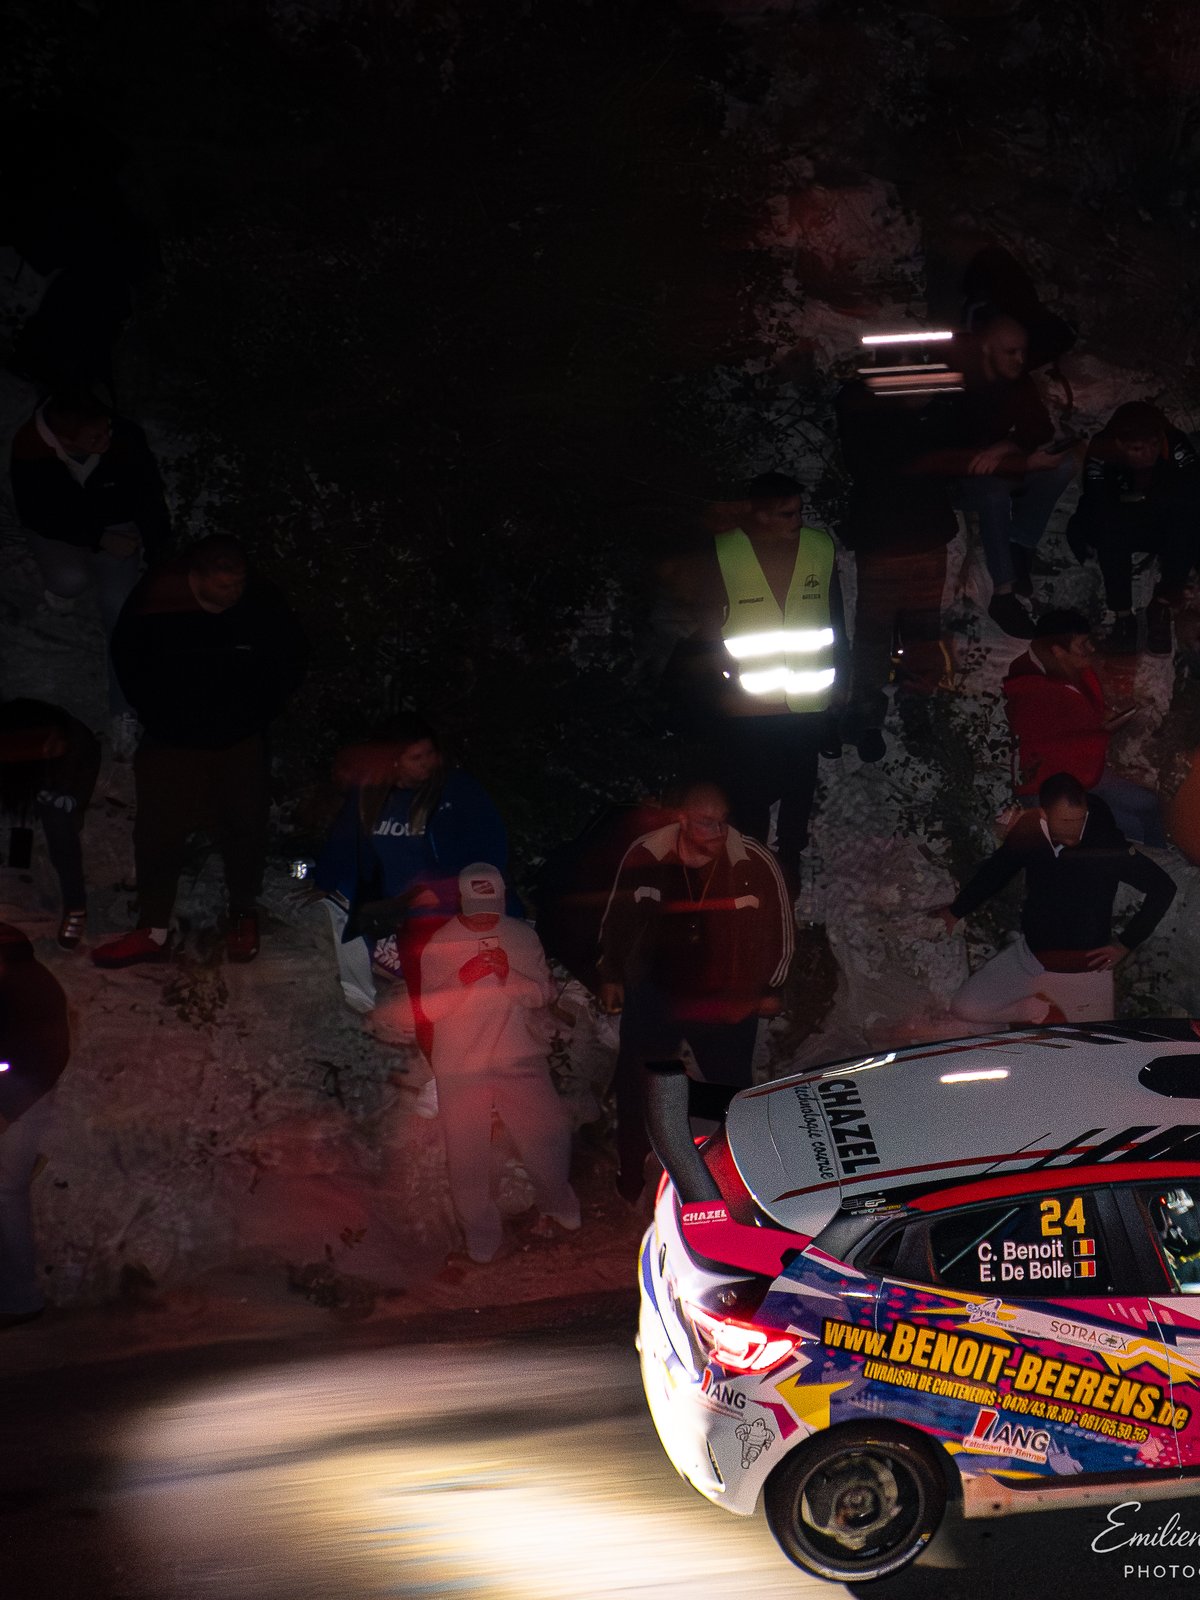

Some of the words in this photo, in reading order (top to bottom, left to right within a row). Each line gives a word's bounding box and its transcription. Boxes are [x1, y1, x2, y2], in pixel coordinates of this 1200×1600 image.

[818, 1079, 880, 1174] CHAZEL
[682, 1209, 727, 1222] CHAZEL
[1040, 1197, 1085, 1236] 24
[978, 1242, 998, 1261] C.
[1003, 1240, 1064, 1260] Benoit
[980, 1264, 996, 1282] E.
[1001, 1263, 1025, 1280] De
[1029, 1260, 1072, 1279] Bolle
[1051, 1320, 1127, 1350] SOTRAGEX
[864, 1361, 919, 1389] LIVRAISON
[917, 1373, 932, 1392] DE
[932, 1376, 998, 1406] CONTENEURS
